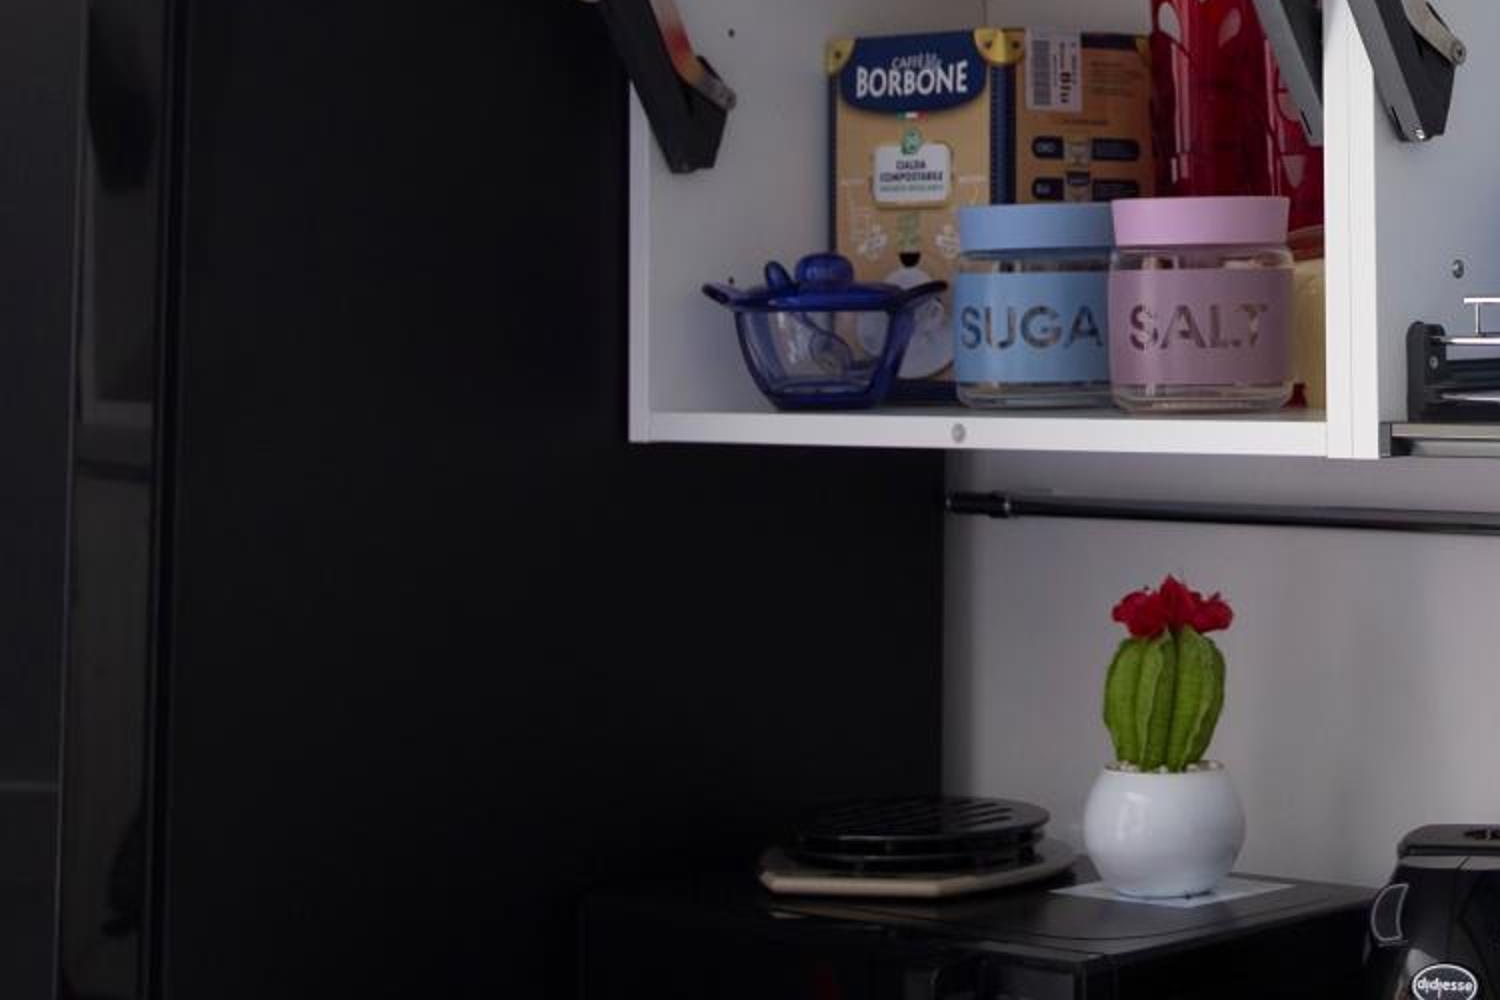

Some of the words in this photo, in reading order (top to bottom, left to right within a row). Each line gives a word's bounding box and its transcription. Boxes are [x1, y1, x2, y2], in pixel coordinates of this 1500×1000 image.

[856, 60, 968, 98] BORBONE
[960, 306, 1105, 350] SUGA
[1129, 304, 1268, 350] SALT
